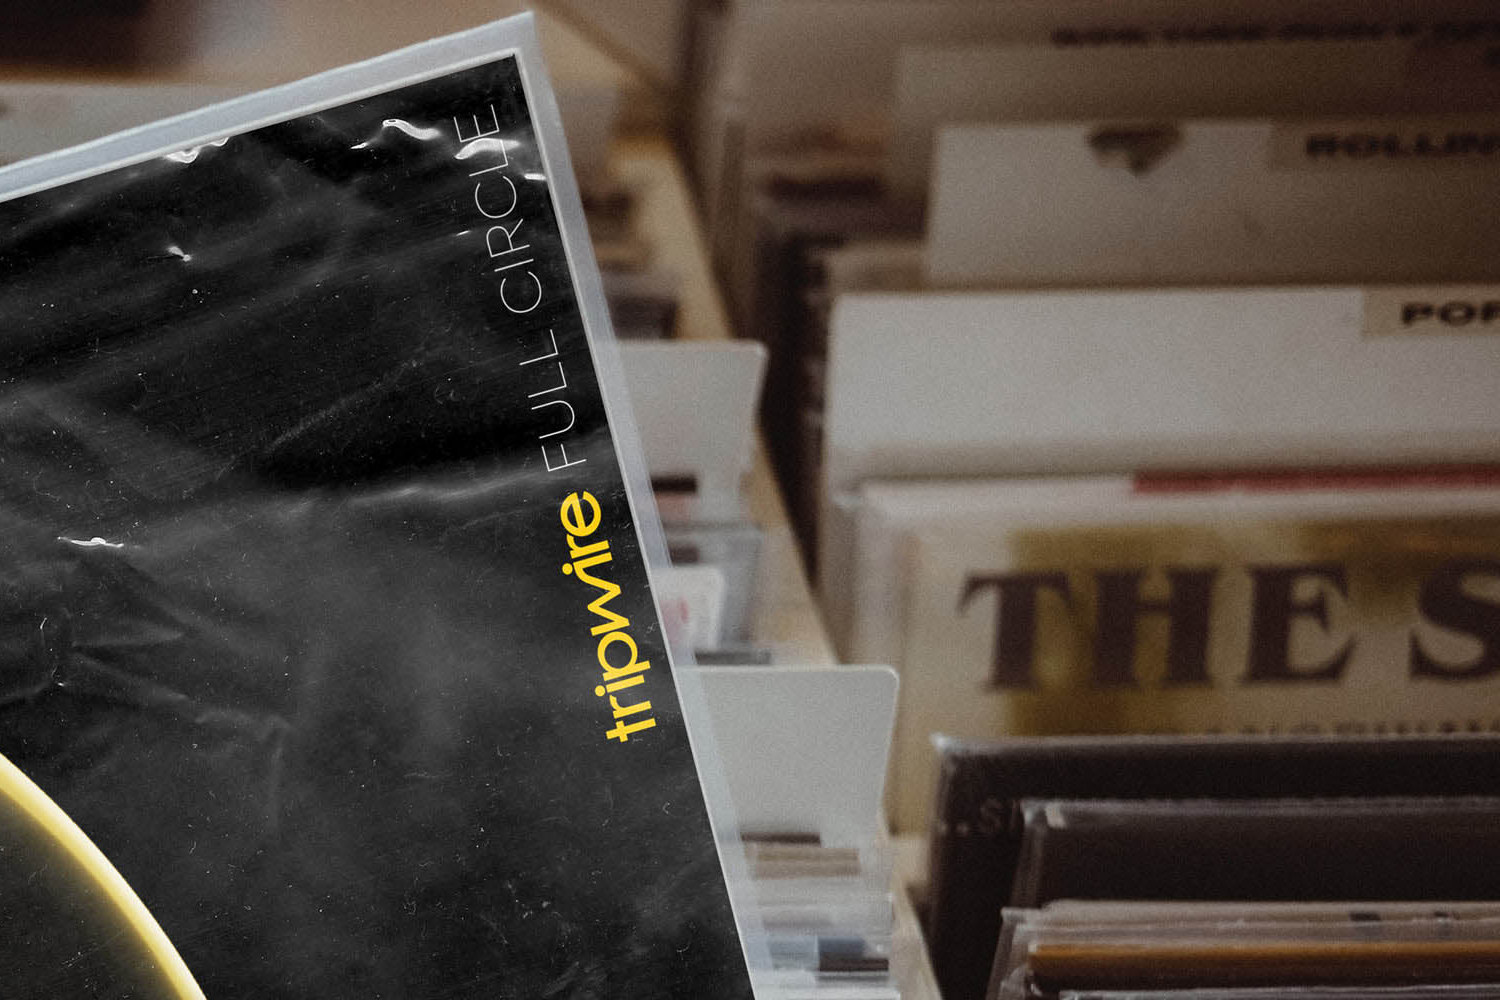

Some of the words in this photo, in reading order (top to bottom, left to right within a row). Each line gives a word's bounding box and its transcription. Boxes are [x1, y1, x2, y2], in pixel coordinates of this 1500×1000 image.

[453, 103, 543, 314] CIRCLE
[518, 328, 588, 473] FULL
[559, 489, 657, 744] tripwire
[956, 561, 1359, 693] THE
